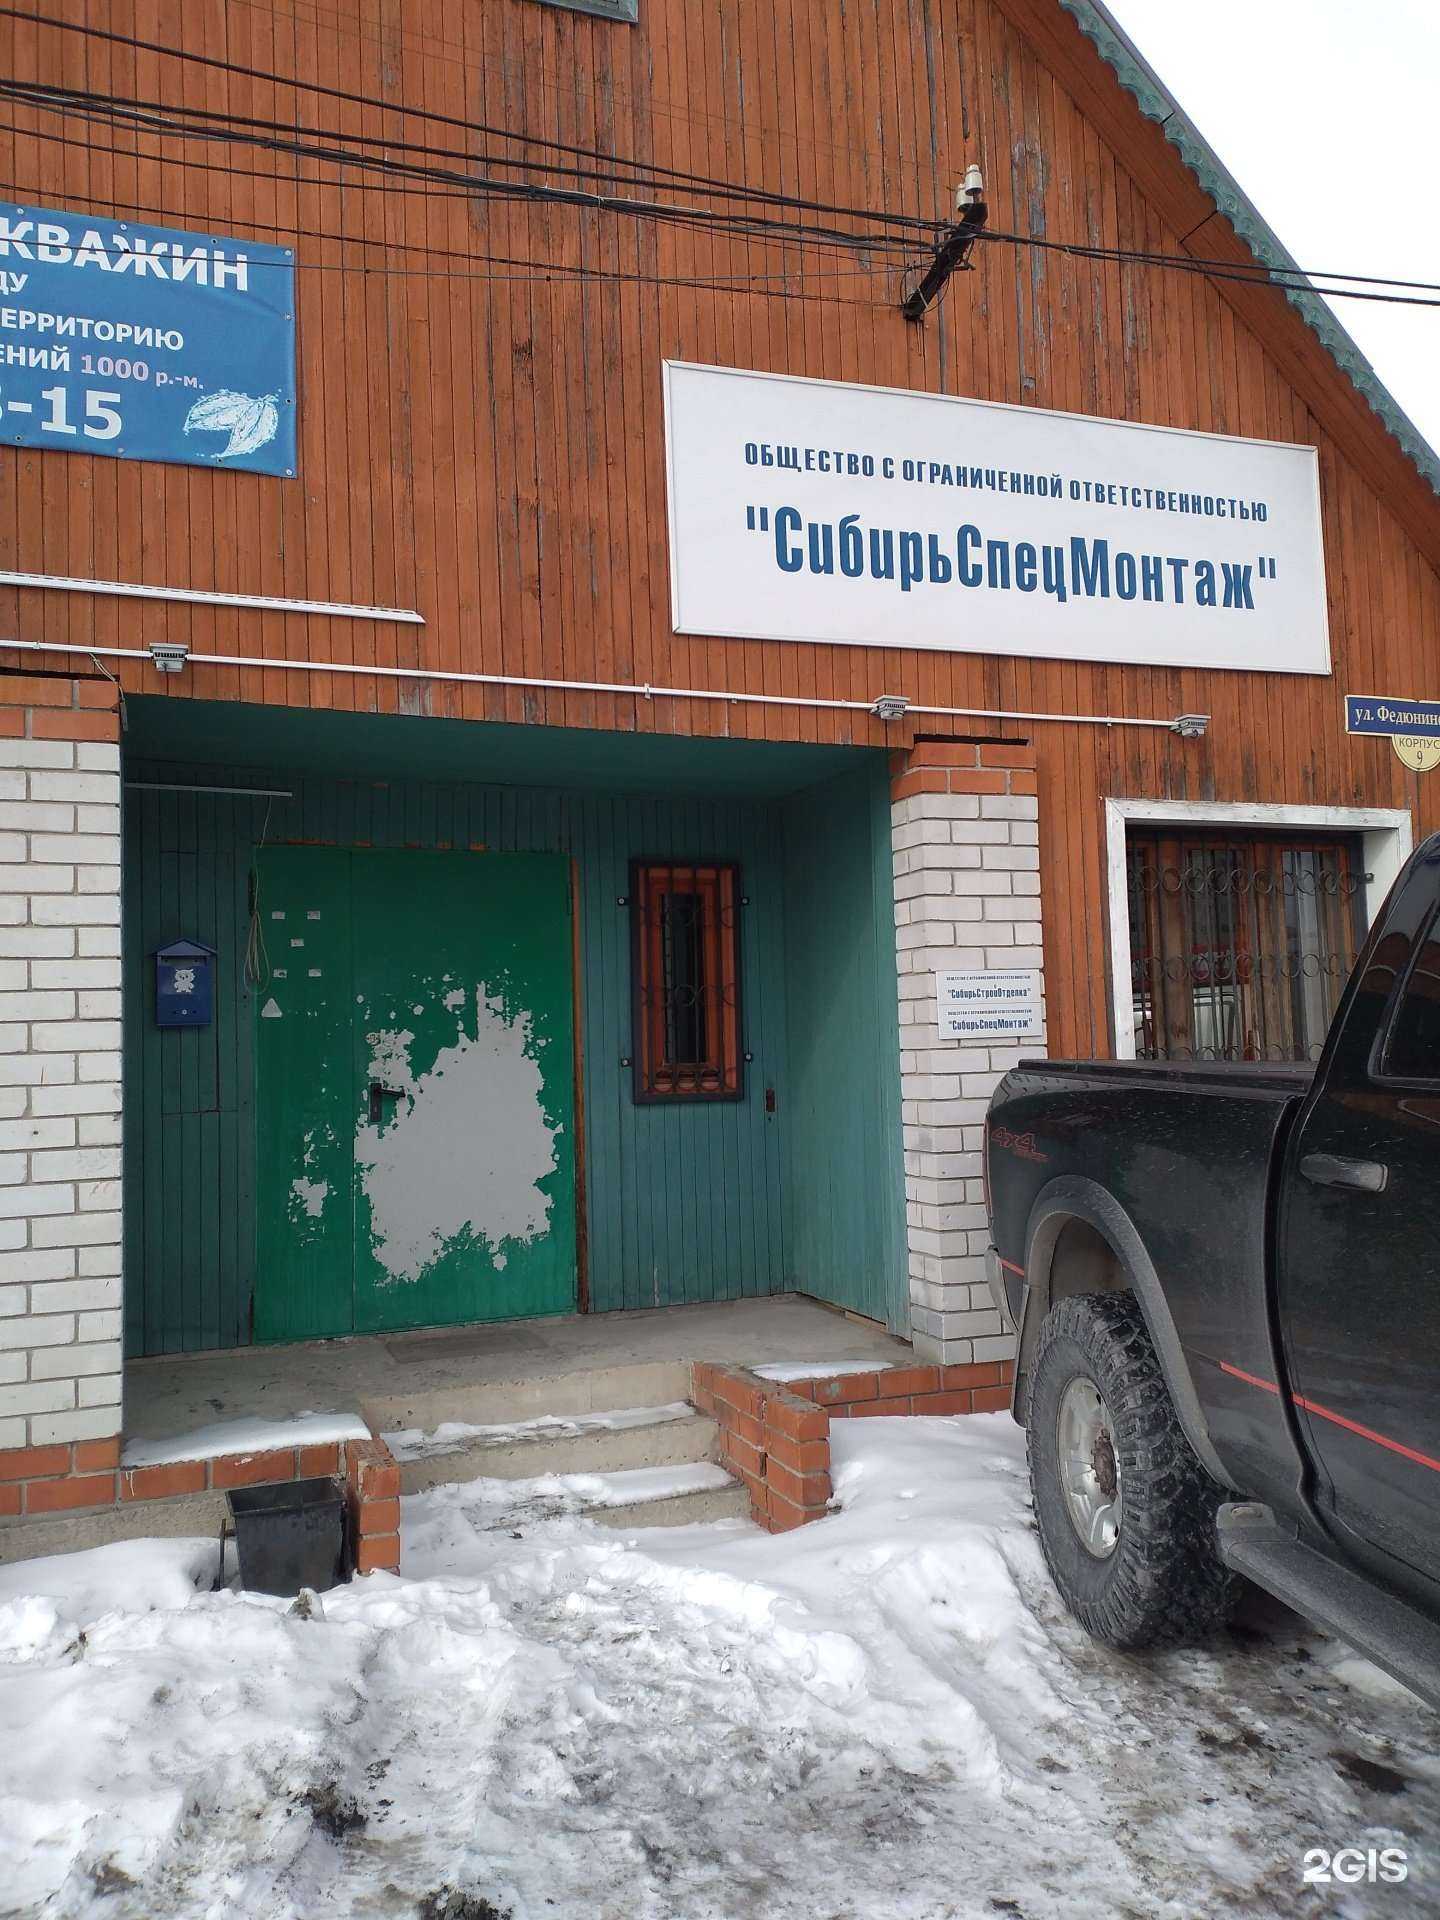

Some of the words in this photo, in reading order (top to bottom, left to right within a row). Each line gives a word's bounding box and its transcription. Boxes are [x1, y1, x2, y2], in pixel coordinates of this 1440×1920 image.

[1, 308, 184, 351] ЕРРИТОРИЮ
[80, 354, 149, 382] 1000
[0, 385, 122, 440] -15
[744, 442, 875, 477] ОБЩЕСТВО
[882, 457, 895, 479] С
[902, 459, 1063, 499] ОГРАНИЧЕННОЙ
[1069, 479, 1268, 522] ОТВЕТСТВЕННОСТЬЮ
[746, 505, 1277, 610] "СибирьСпецМонтаж"
[1355, 708, 1374, 725] ул.
[1416, 750, 1423, 765] 9
